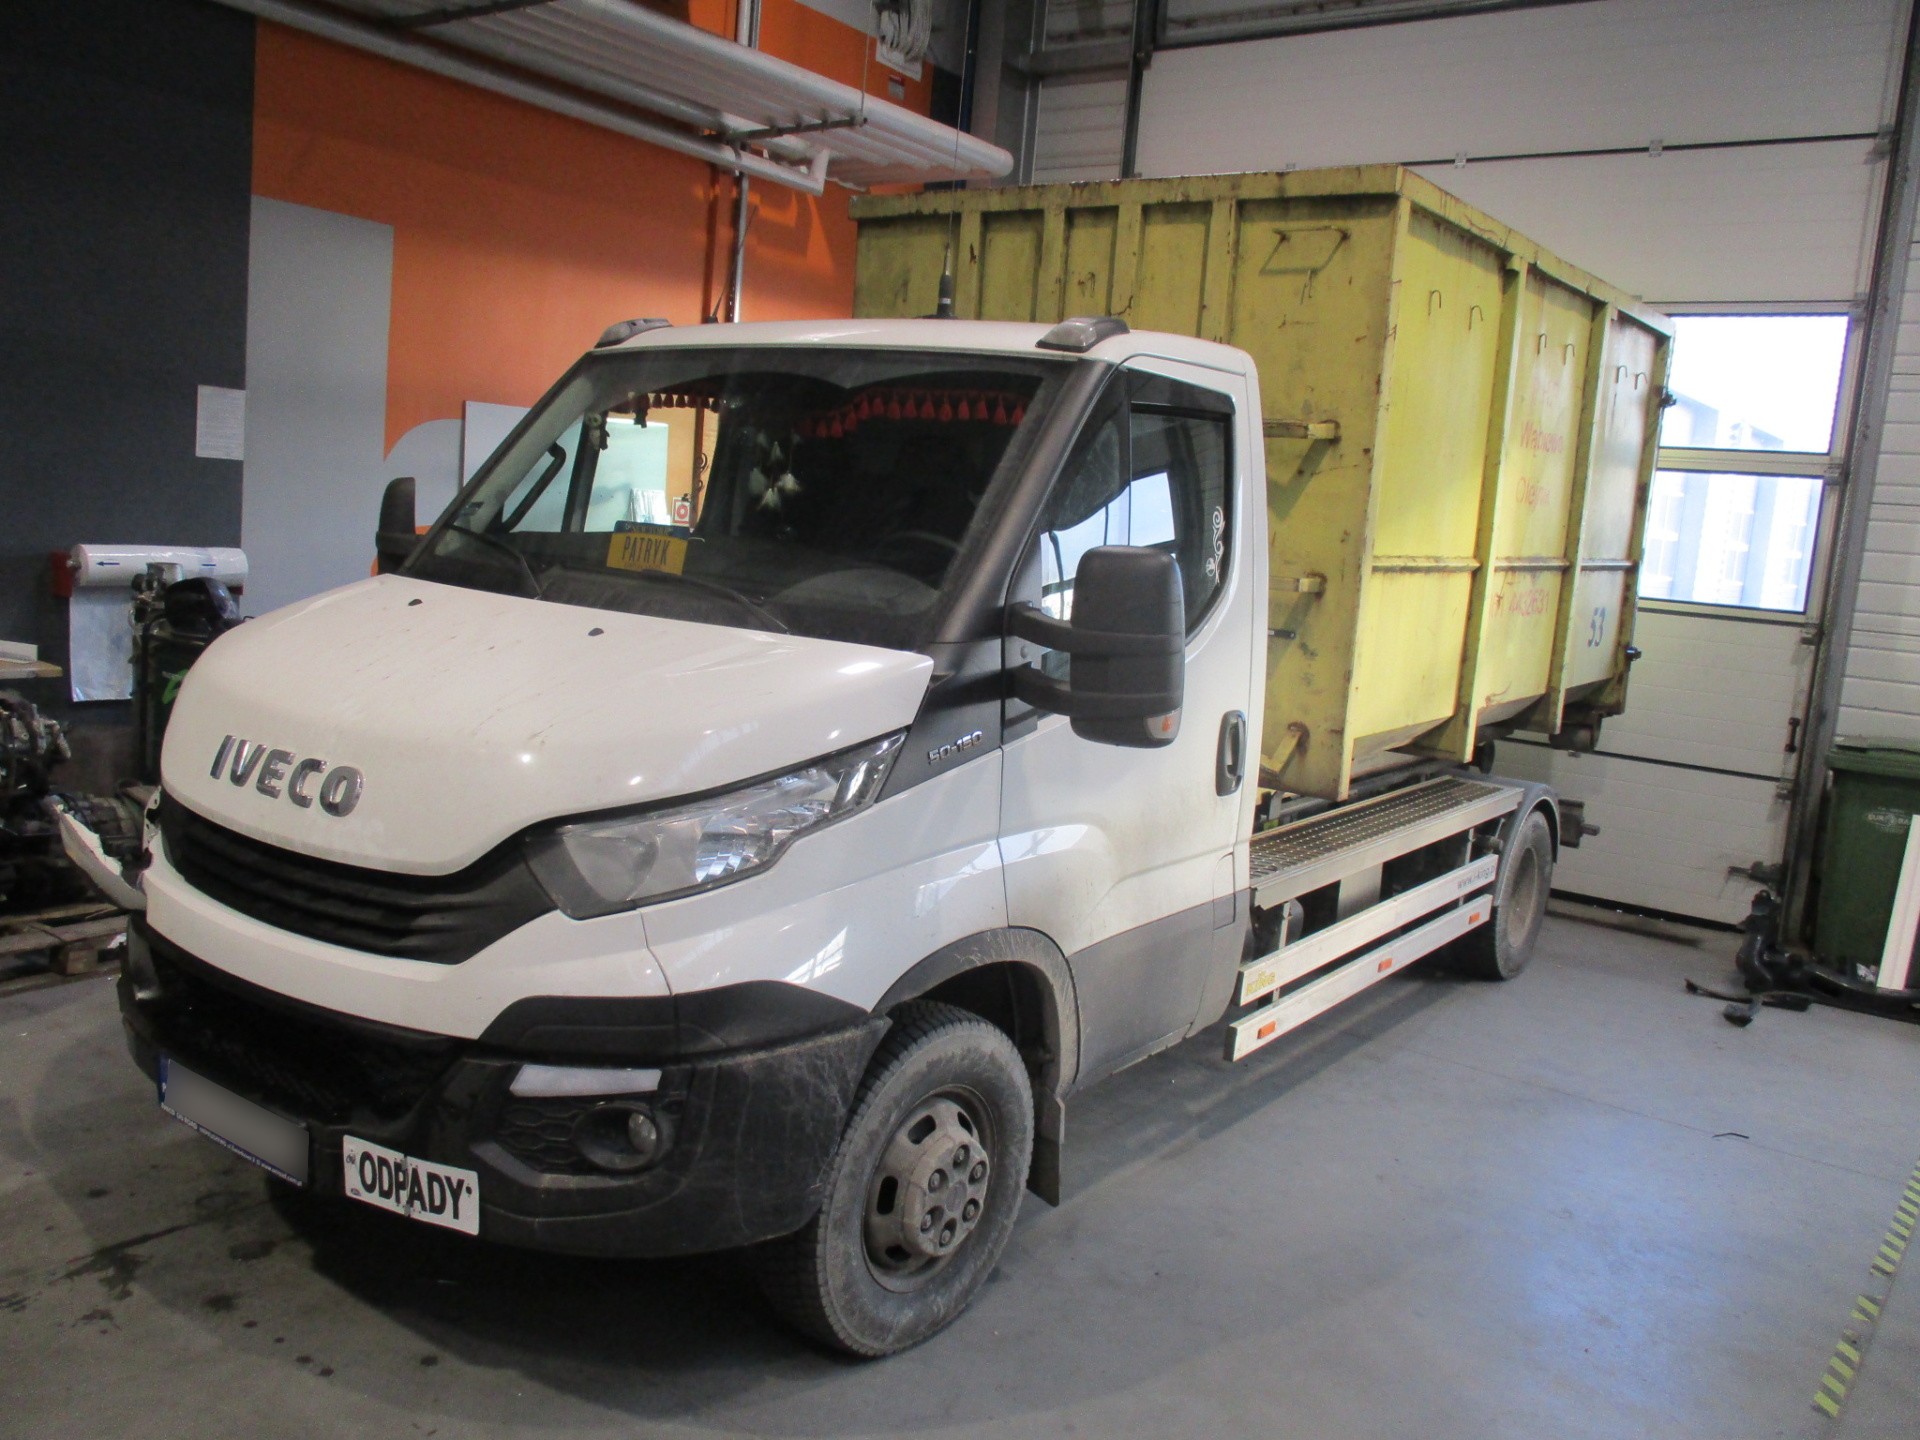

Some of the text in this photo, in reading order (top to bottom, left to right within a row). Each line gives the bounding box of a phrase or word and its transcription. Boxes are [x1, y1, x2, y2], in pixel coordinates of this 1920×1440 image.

[622, 535, 671, 566] PATRYK
[209, 734, 365, 818] IVECO
[359, 1150, 465, 1220] ODPADY
